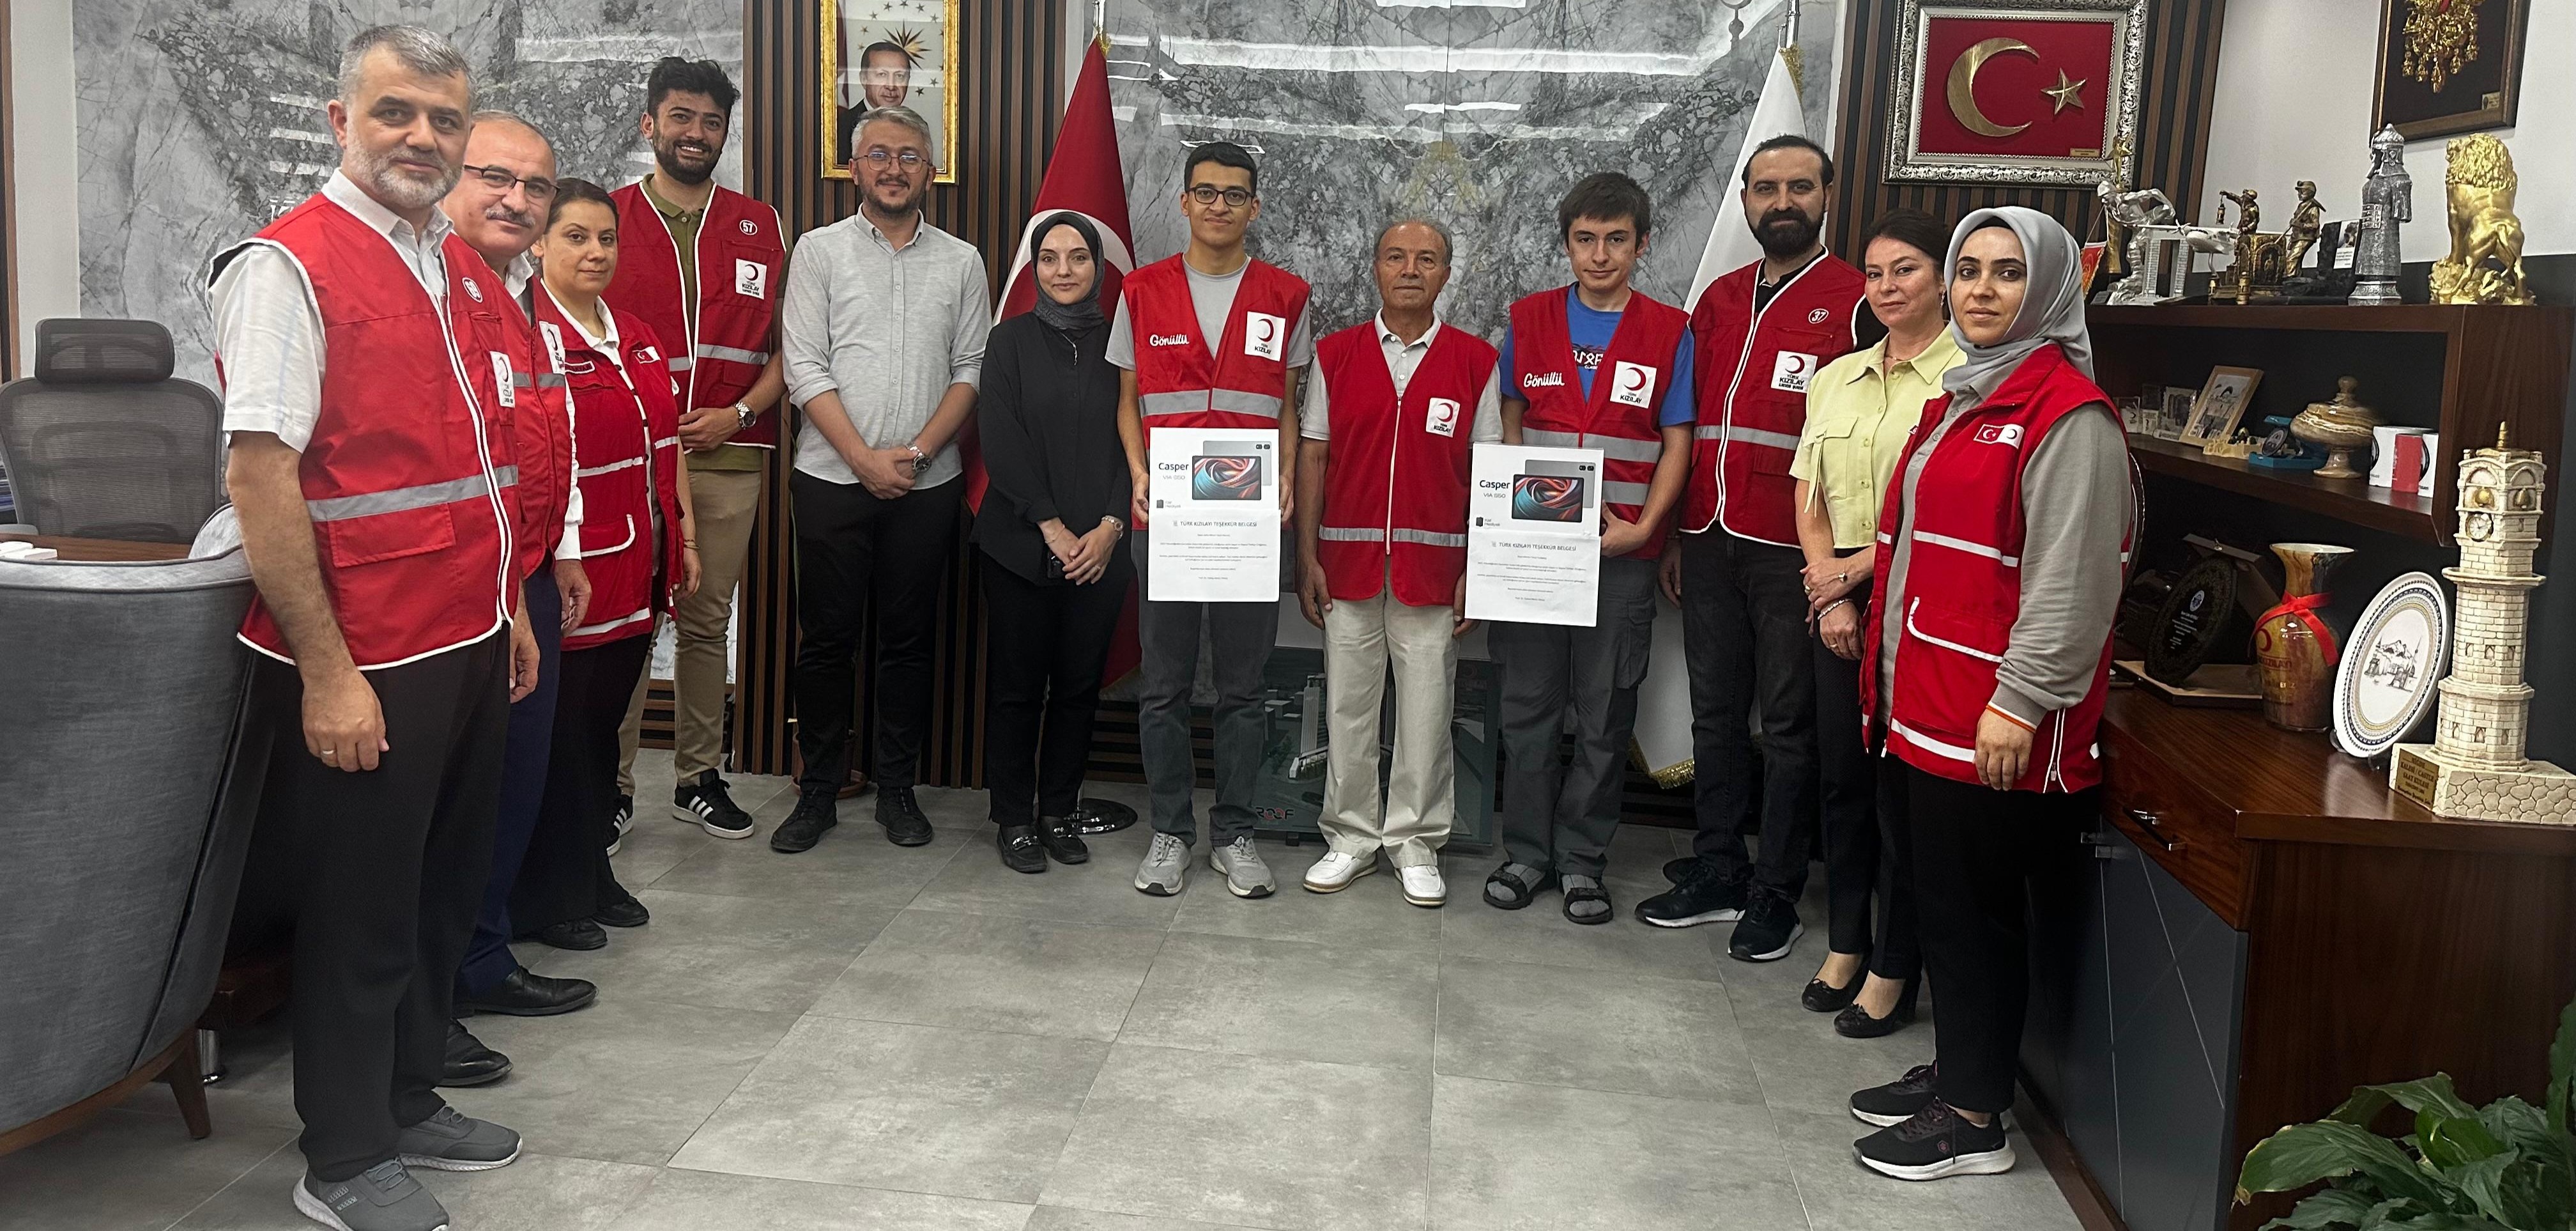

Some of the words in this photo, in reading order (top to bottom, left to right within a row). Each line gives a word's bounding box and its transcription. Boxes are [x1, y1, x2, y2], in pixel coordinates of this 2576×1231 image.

[742, 221, 753, 233] 57
[1811, 311, 1827, 321] 37
[1149, 334, 1190, 346] Gönüllü
[1523, 371, 1565, 387] Gönüllü
[1779, 376, 1805, 385] KIZILAY
[1620, 394, 1643, 404] KIZILAY
[1158, 462, 1190, 472] Casper
[1479, 480, 1511, 490] Casper
